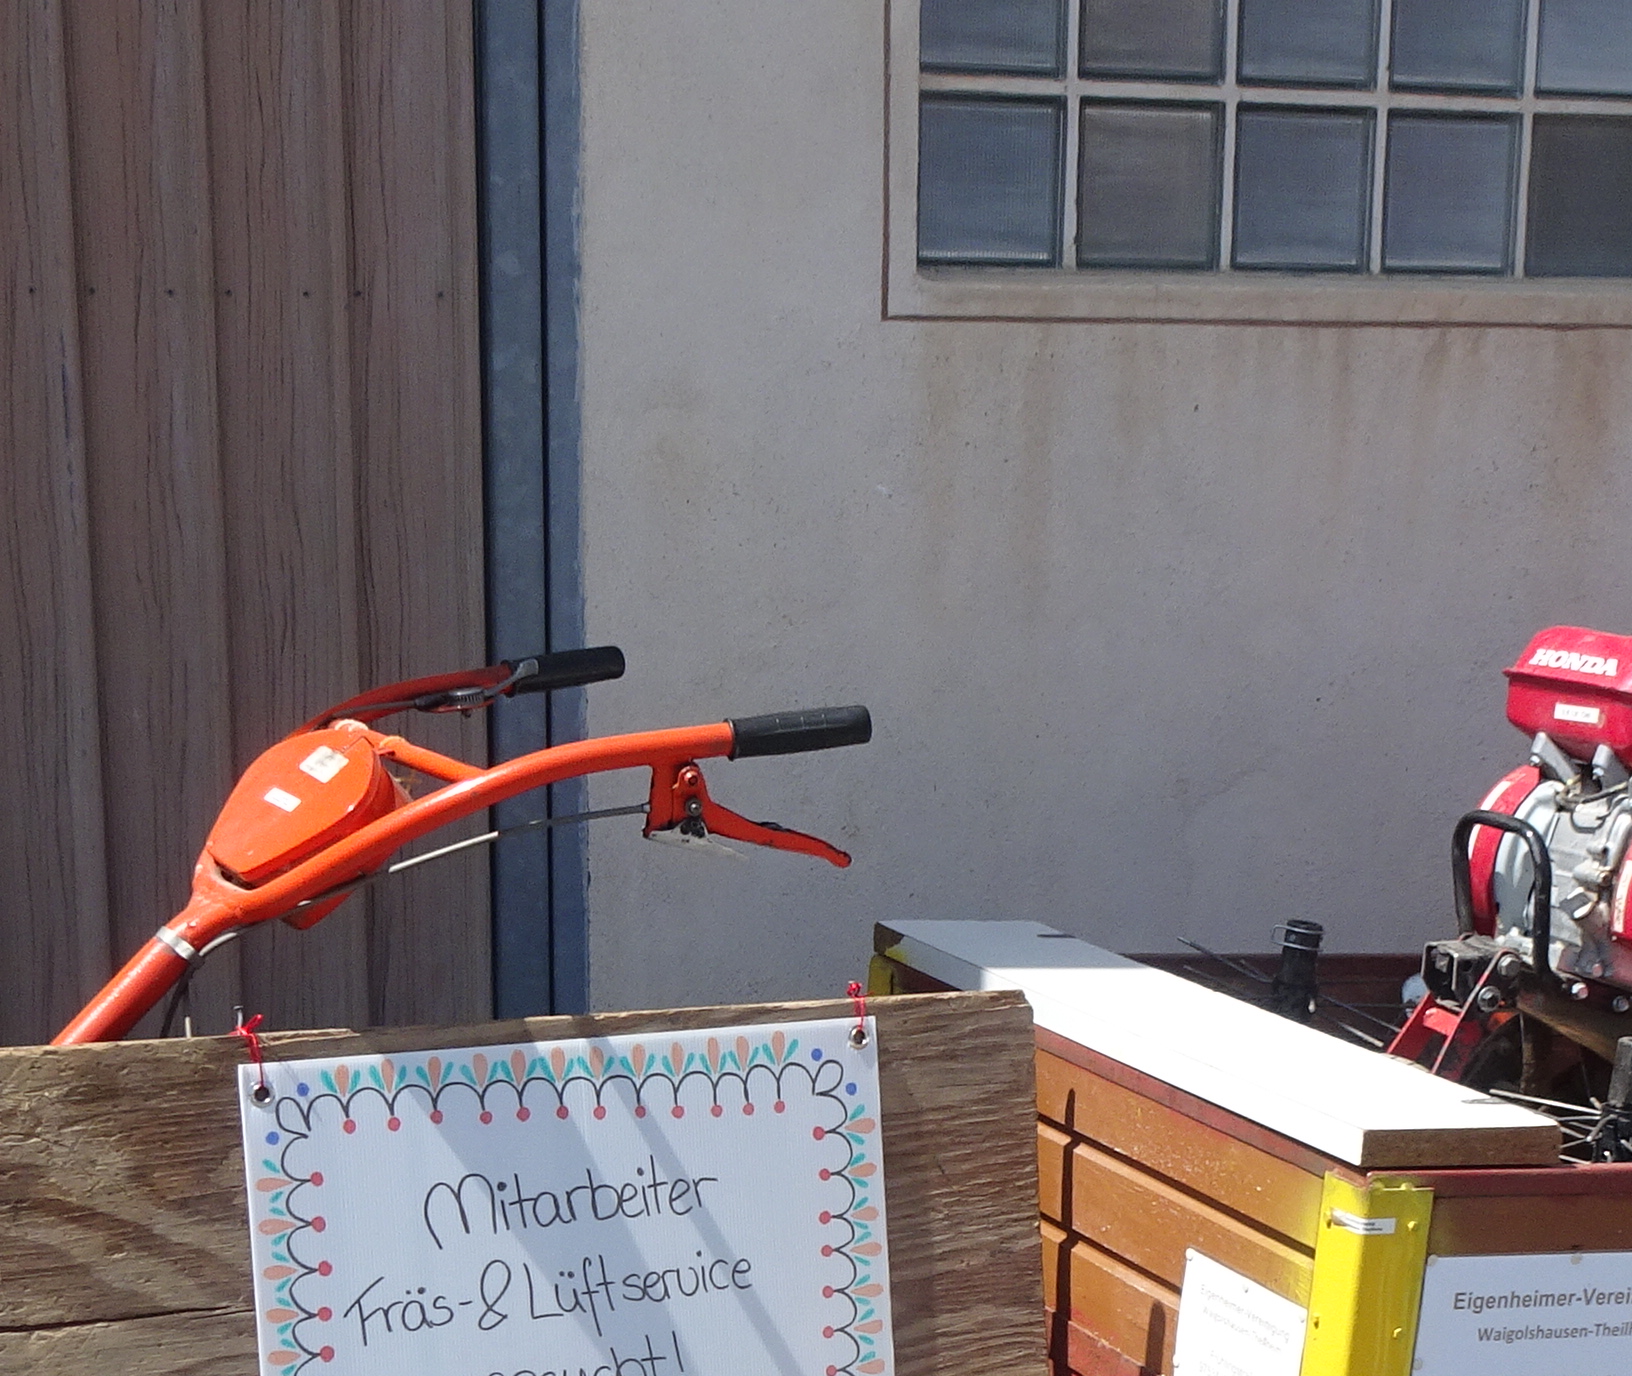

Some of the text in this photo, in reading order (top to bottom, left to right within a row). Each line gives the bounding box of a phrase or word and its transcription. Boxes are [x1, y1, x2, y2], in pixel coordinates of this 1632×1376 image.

[1528, 648, 1619, 677] HONDA
[423, 1154, 718, 1250] Mitarbeiter
[523, 1250, 752, 1337] Lüftservice
